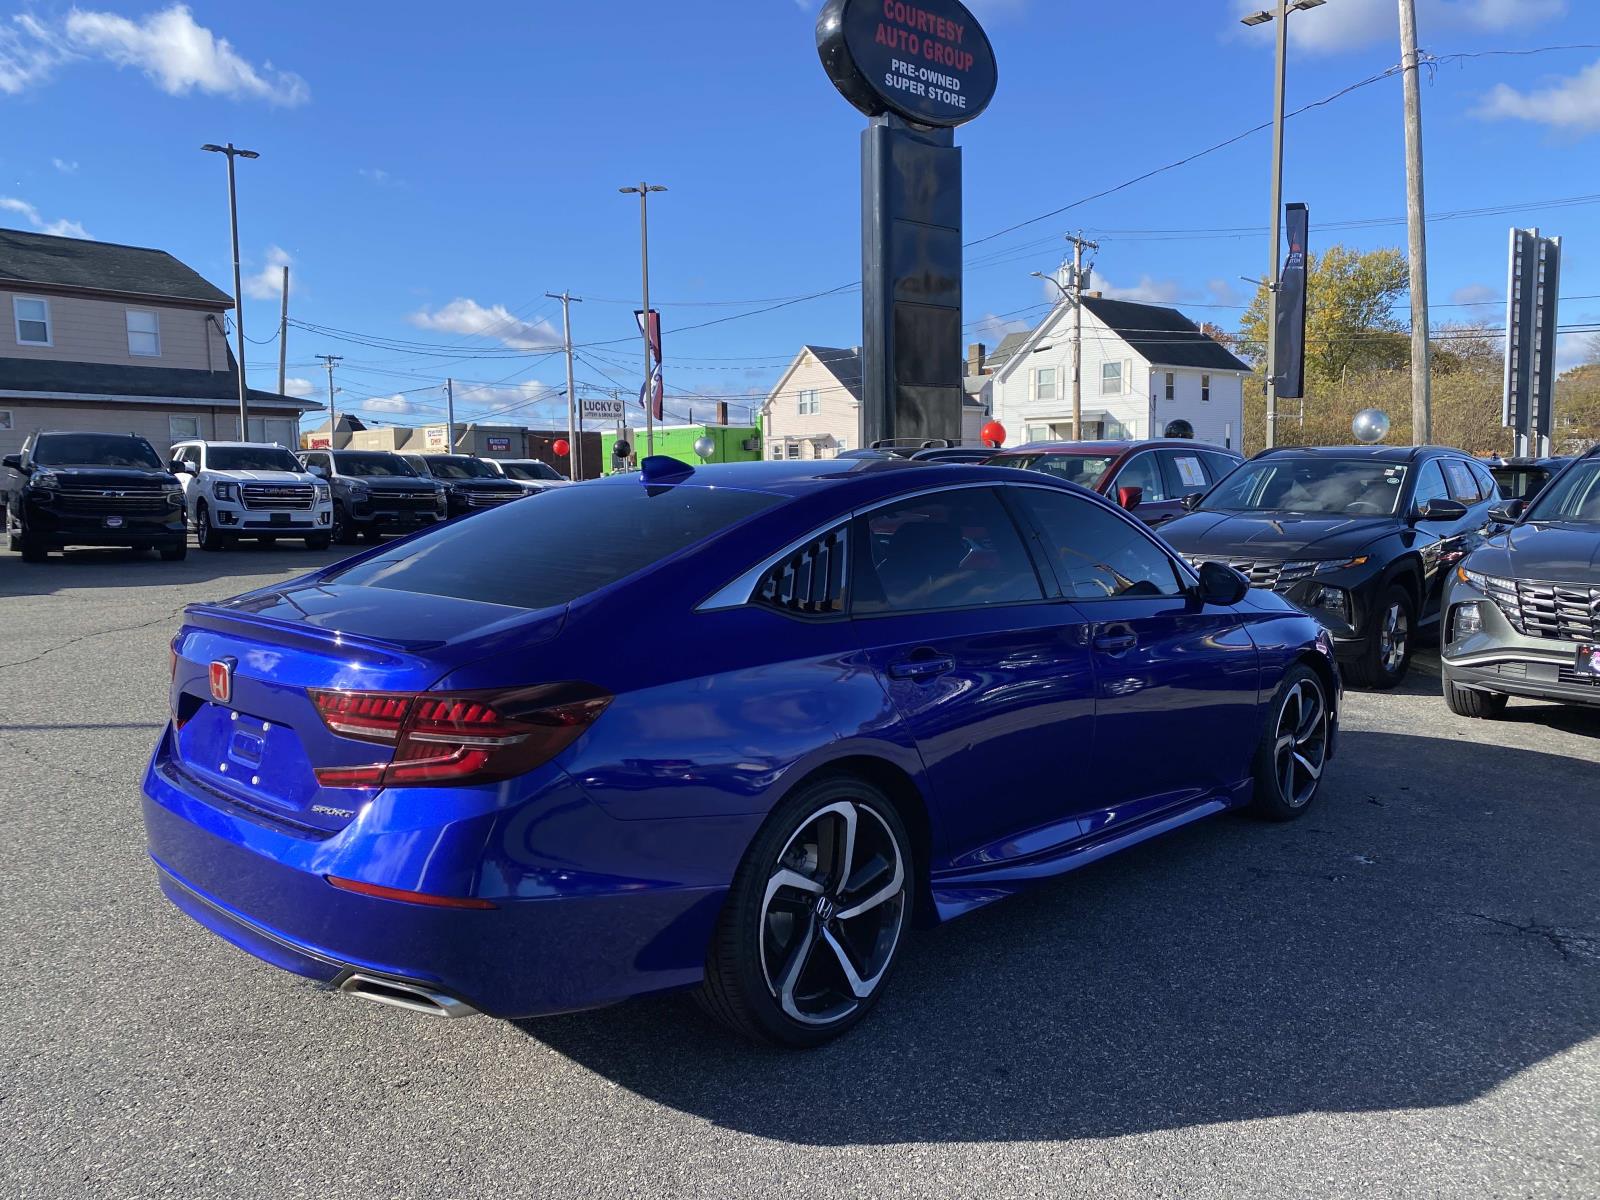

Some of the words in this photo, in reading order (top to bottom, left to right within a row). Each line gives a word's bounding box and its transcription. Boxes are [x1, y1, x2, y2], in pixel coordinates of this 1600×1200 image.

[883, 0, 964, 43] COURTESY
[875, 23, 919, 54] AUTO
[923, 39, 973, 72] GROUP
[885, 73, 925, 96] SUPER
[928, 87, 966, 109] STORE
[891, 58, 960, 91] PRE-OWNED
[584, 401, 612, 411] LUCKY
[311, 804, 355, 818] SPORT
